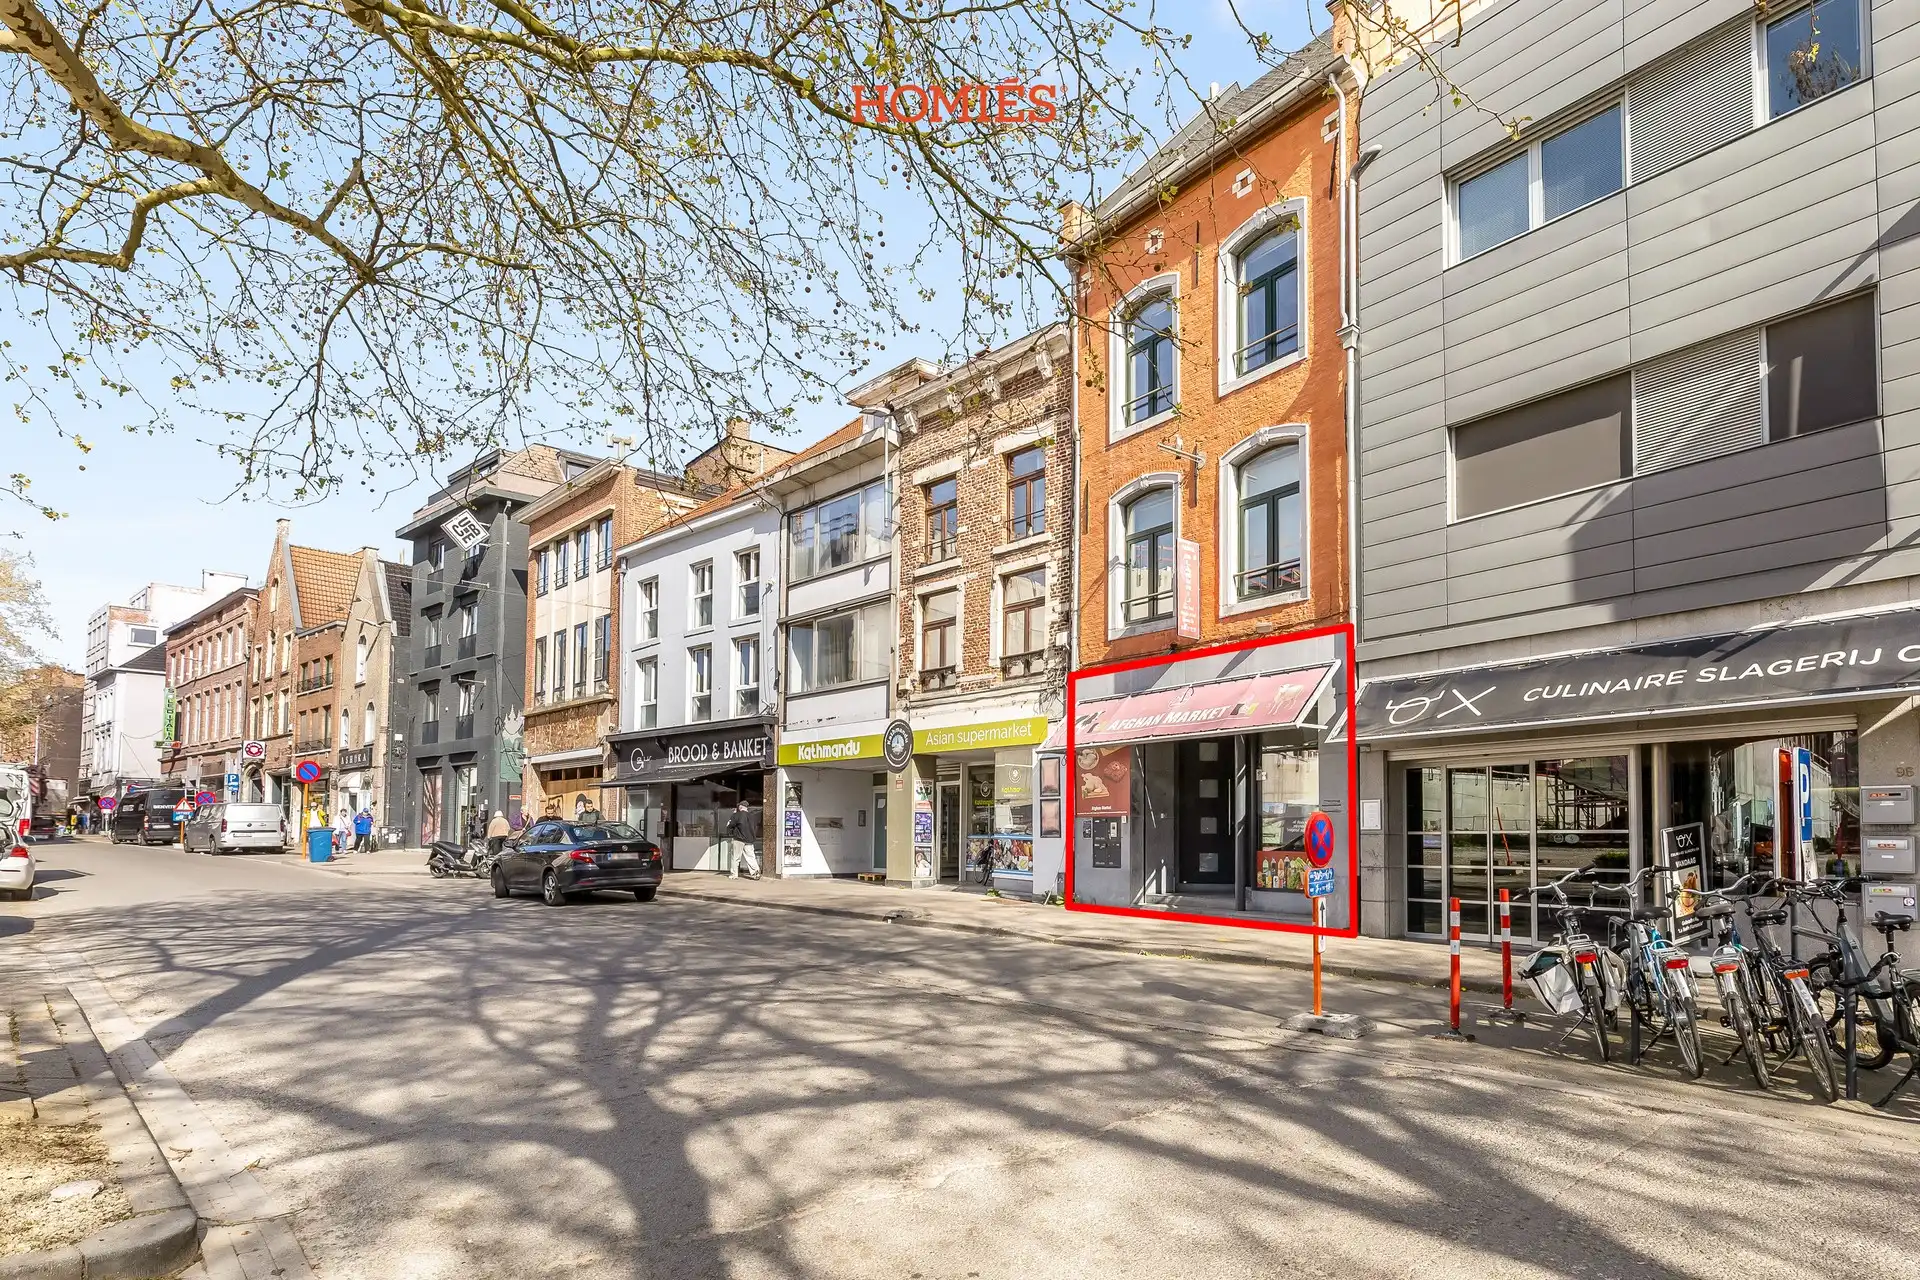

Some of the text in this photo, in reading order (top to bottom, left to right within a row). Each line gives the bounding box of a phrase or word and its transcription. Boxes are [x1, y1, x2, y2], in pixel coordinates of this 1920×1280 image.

[1523, 669, 1688, 702] CULINAIRE
[1696, 647, 1882, 683] SLAGERIJ
[1107, 705, 1232, 731] AFGHAN MARKET
[925, 721, 1032, 746] Asian supermarket
[668, 737, 769, 764] BROOD & BANKET
[798, 739, 861, 761] Kathmandu
[229, 774, 236, 782] P
[1895, 766, 1915, 778] 96
[1800, 763, 1810, 827] P
